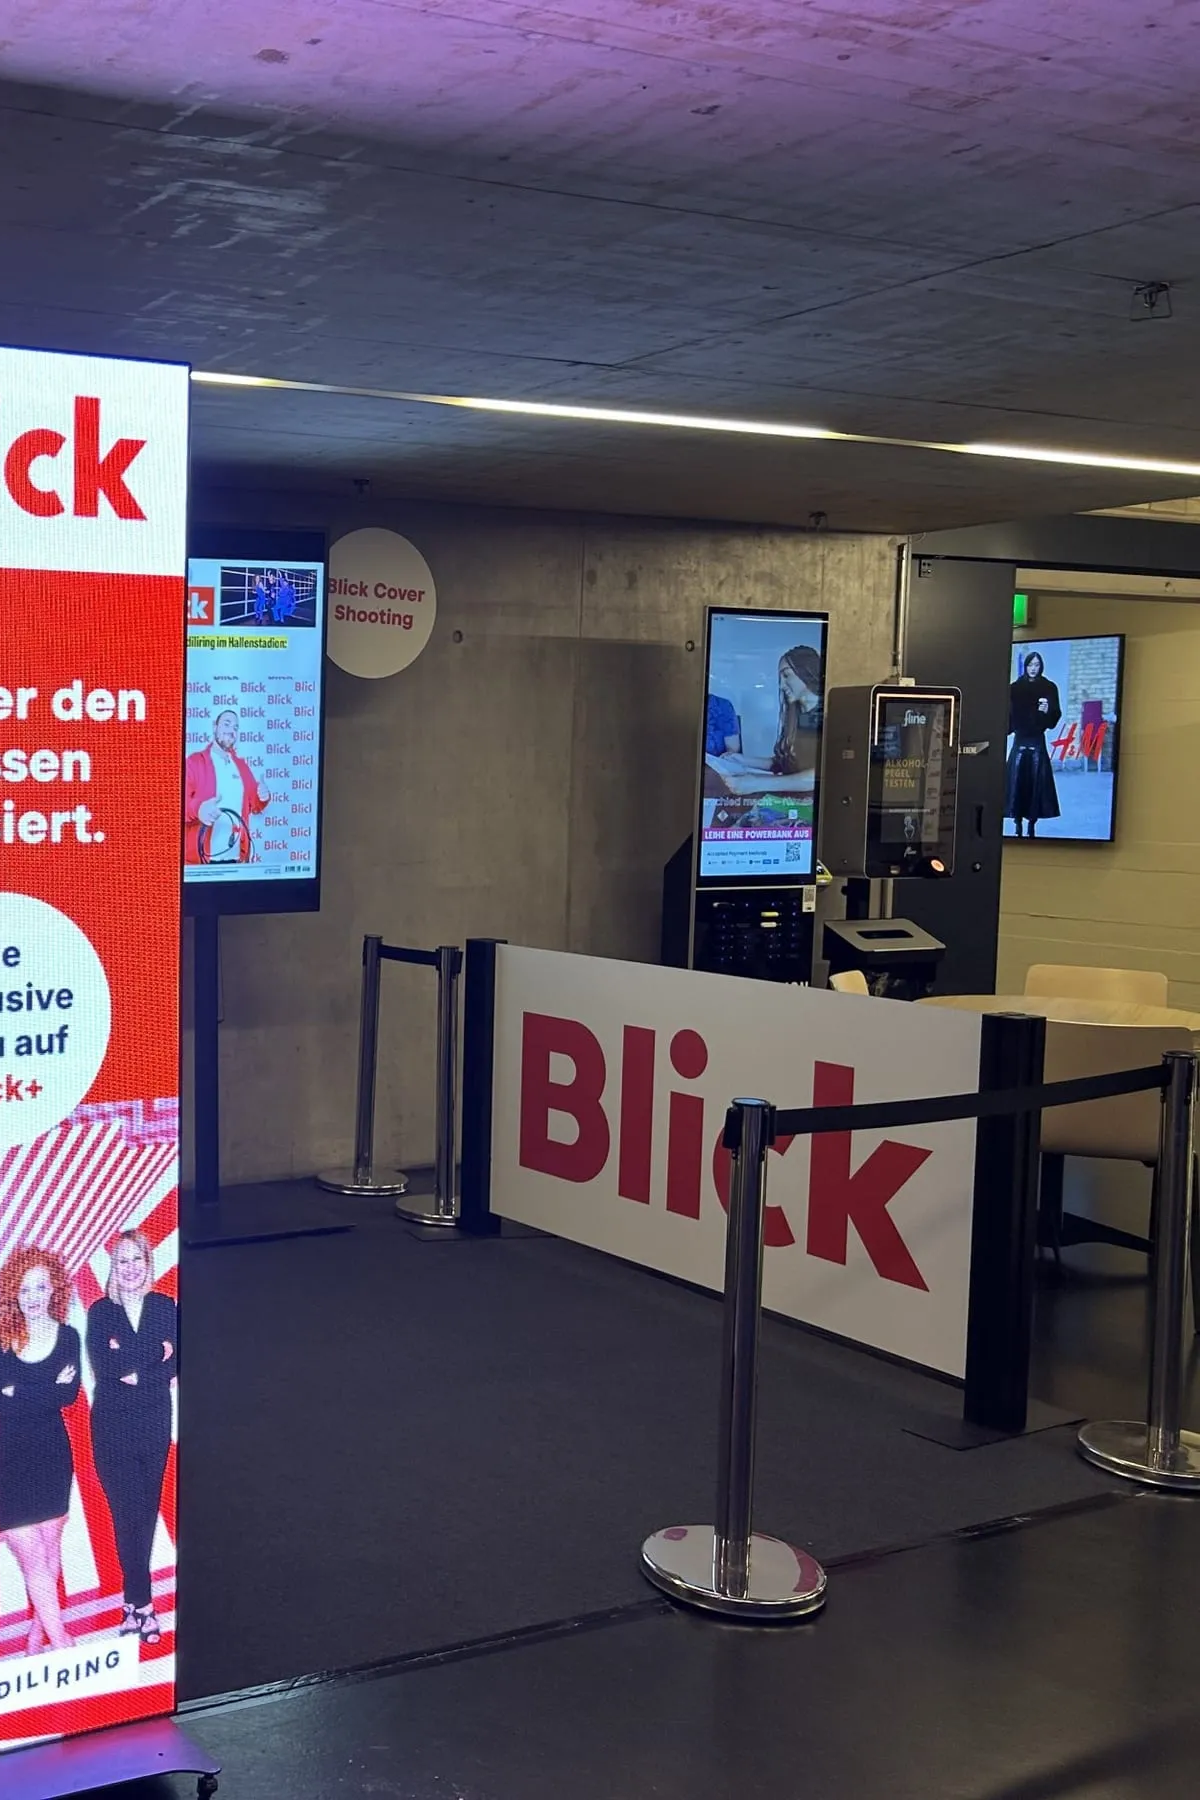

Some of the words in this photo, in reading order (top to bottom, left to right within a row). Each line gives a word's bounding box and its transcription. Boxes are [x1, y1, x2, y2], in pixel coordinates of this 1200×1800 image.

[374, 582, 426, 602] Cover
[334, 604, 413, 630] Shooting
[240, 682, 266, 693] Blick
[51, 679, 146, 721] den
[213, 695, 238, 706] Blick
[267, 694, 292, 705] Blick
[240, 707, 265, 718] Blick
[267, 719, 292, 730] Blick
[239, 732, 265, 743] Blick
[1050, 721, 1108, 762] H&M
[266, 744, 291, 755] Blick
[265, 768, 290, 779] Blick
[884, 779, 915, 788] TESTEN
[264, 817, 289, 827] Blick
[704, 830, 726, 840] LEIHE
[727, 830, 744, 839] EINE
[745, 830, 793, 839] POWERBANK
[793, 829, 809, 839] AUS
[264, 840, 288, 851] Blick
[15, 1024, 69, 1056] auf
